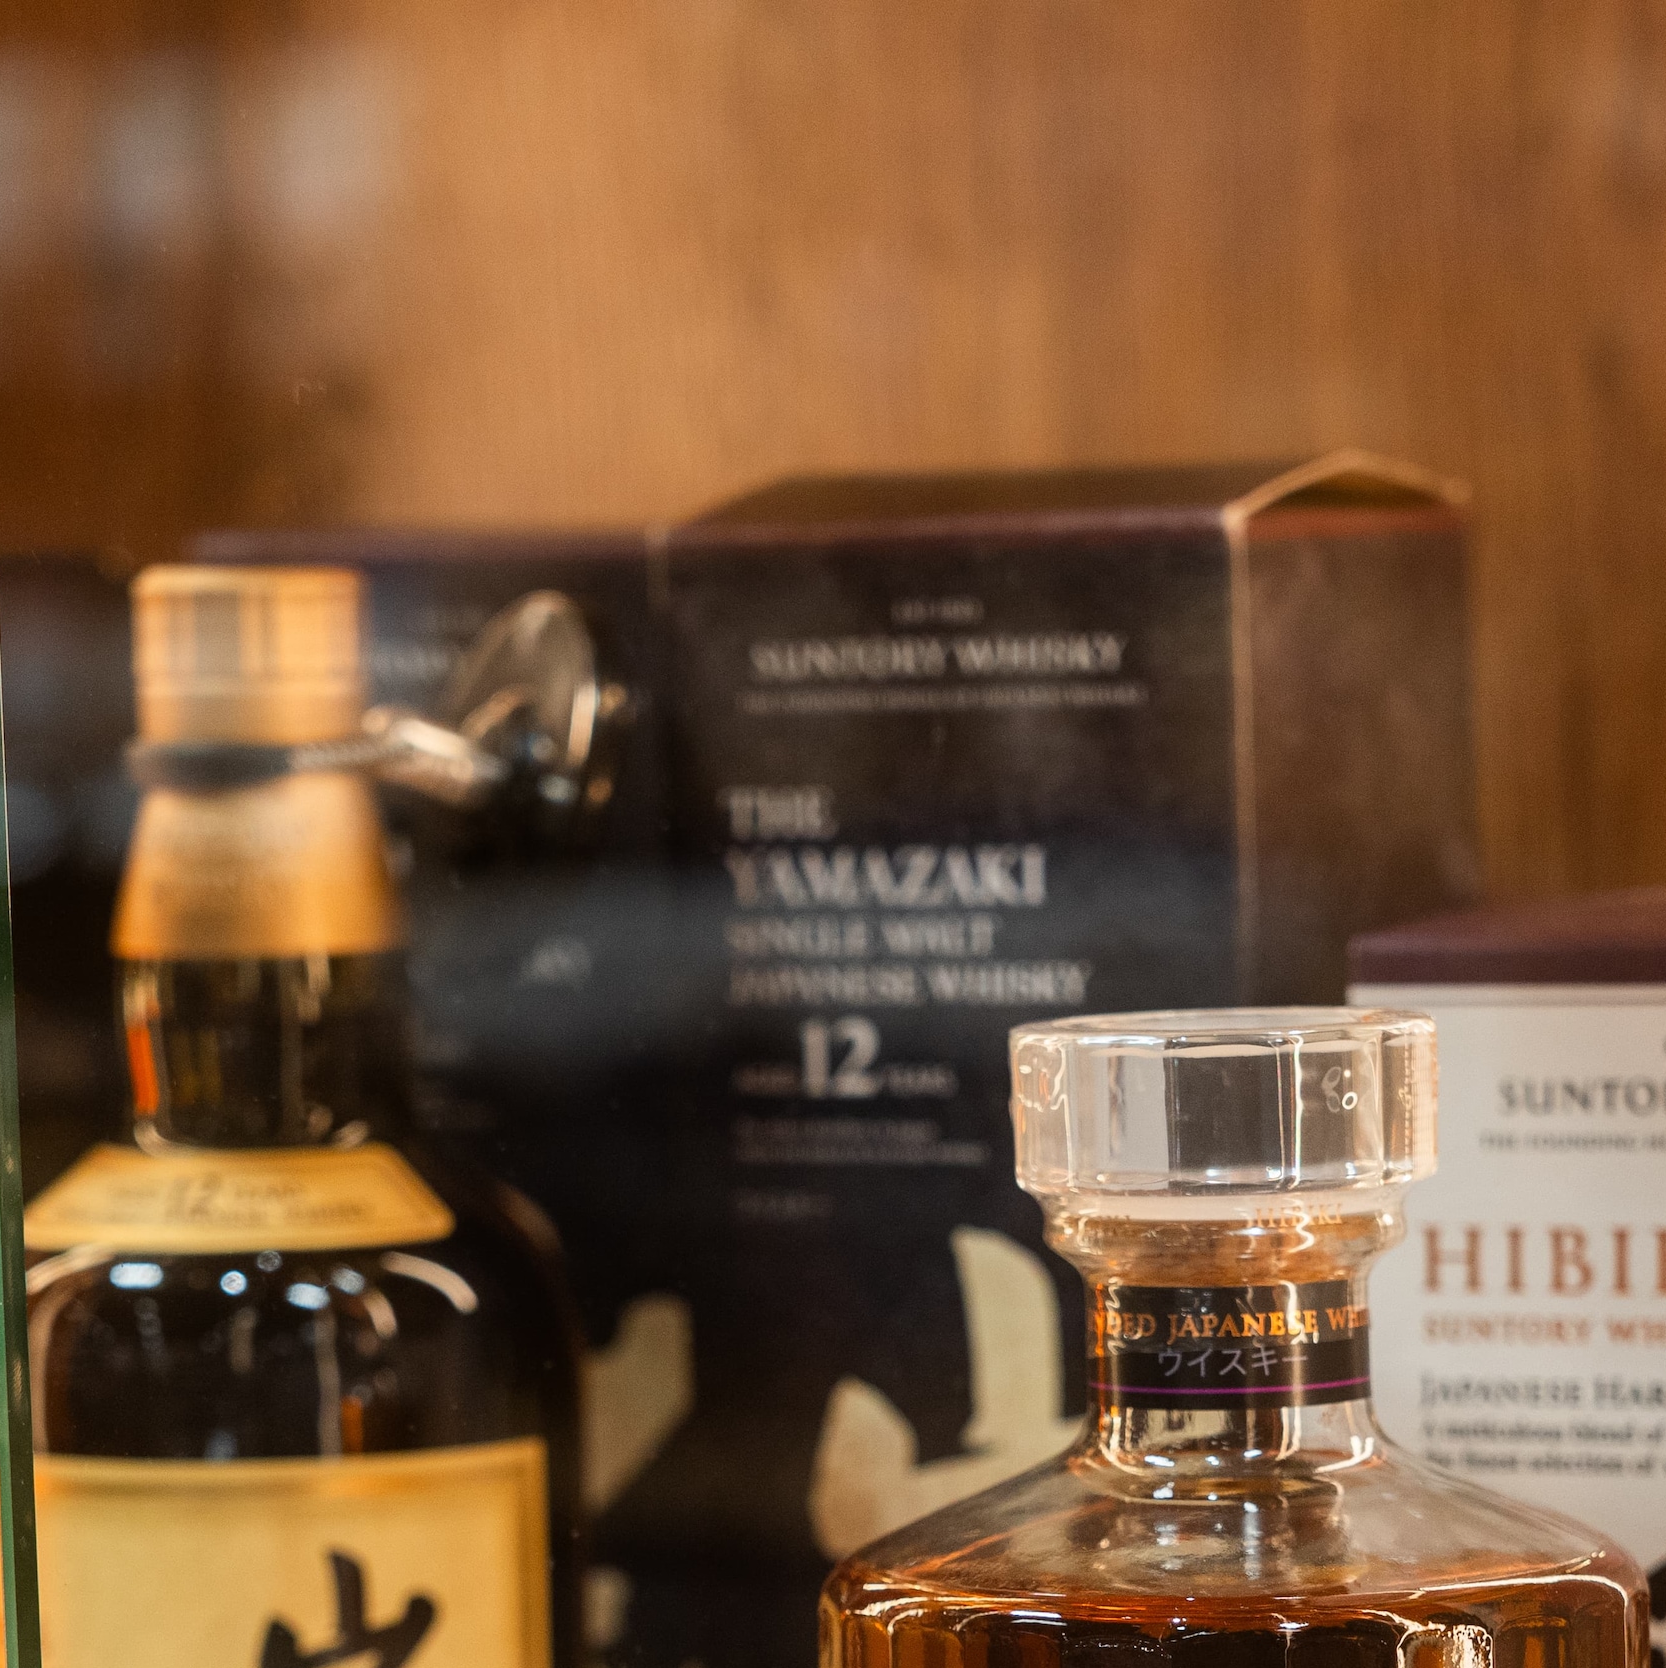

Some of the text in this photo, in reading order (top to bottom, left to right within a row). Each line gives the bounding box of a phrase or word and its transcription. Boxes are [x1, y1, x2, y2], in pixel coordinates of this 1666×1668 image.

[726, 844, 1046, 905] YAMAZAKI
[1159, 1346, 1308, 1377] ウイスキー
